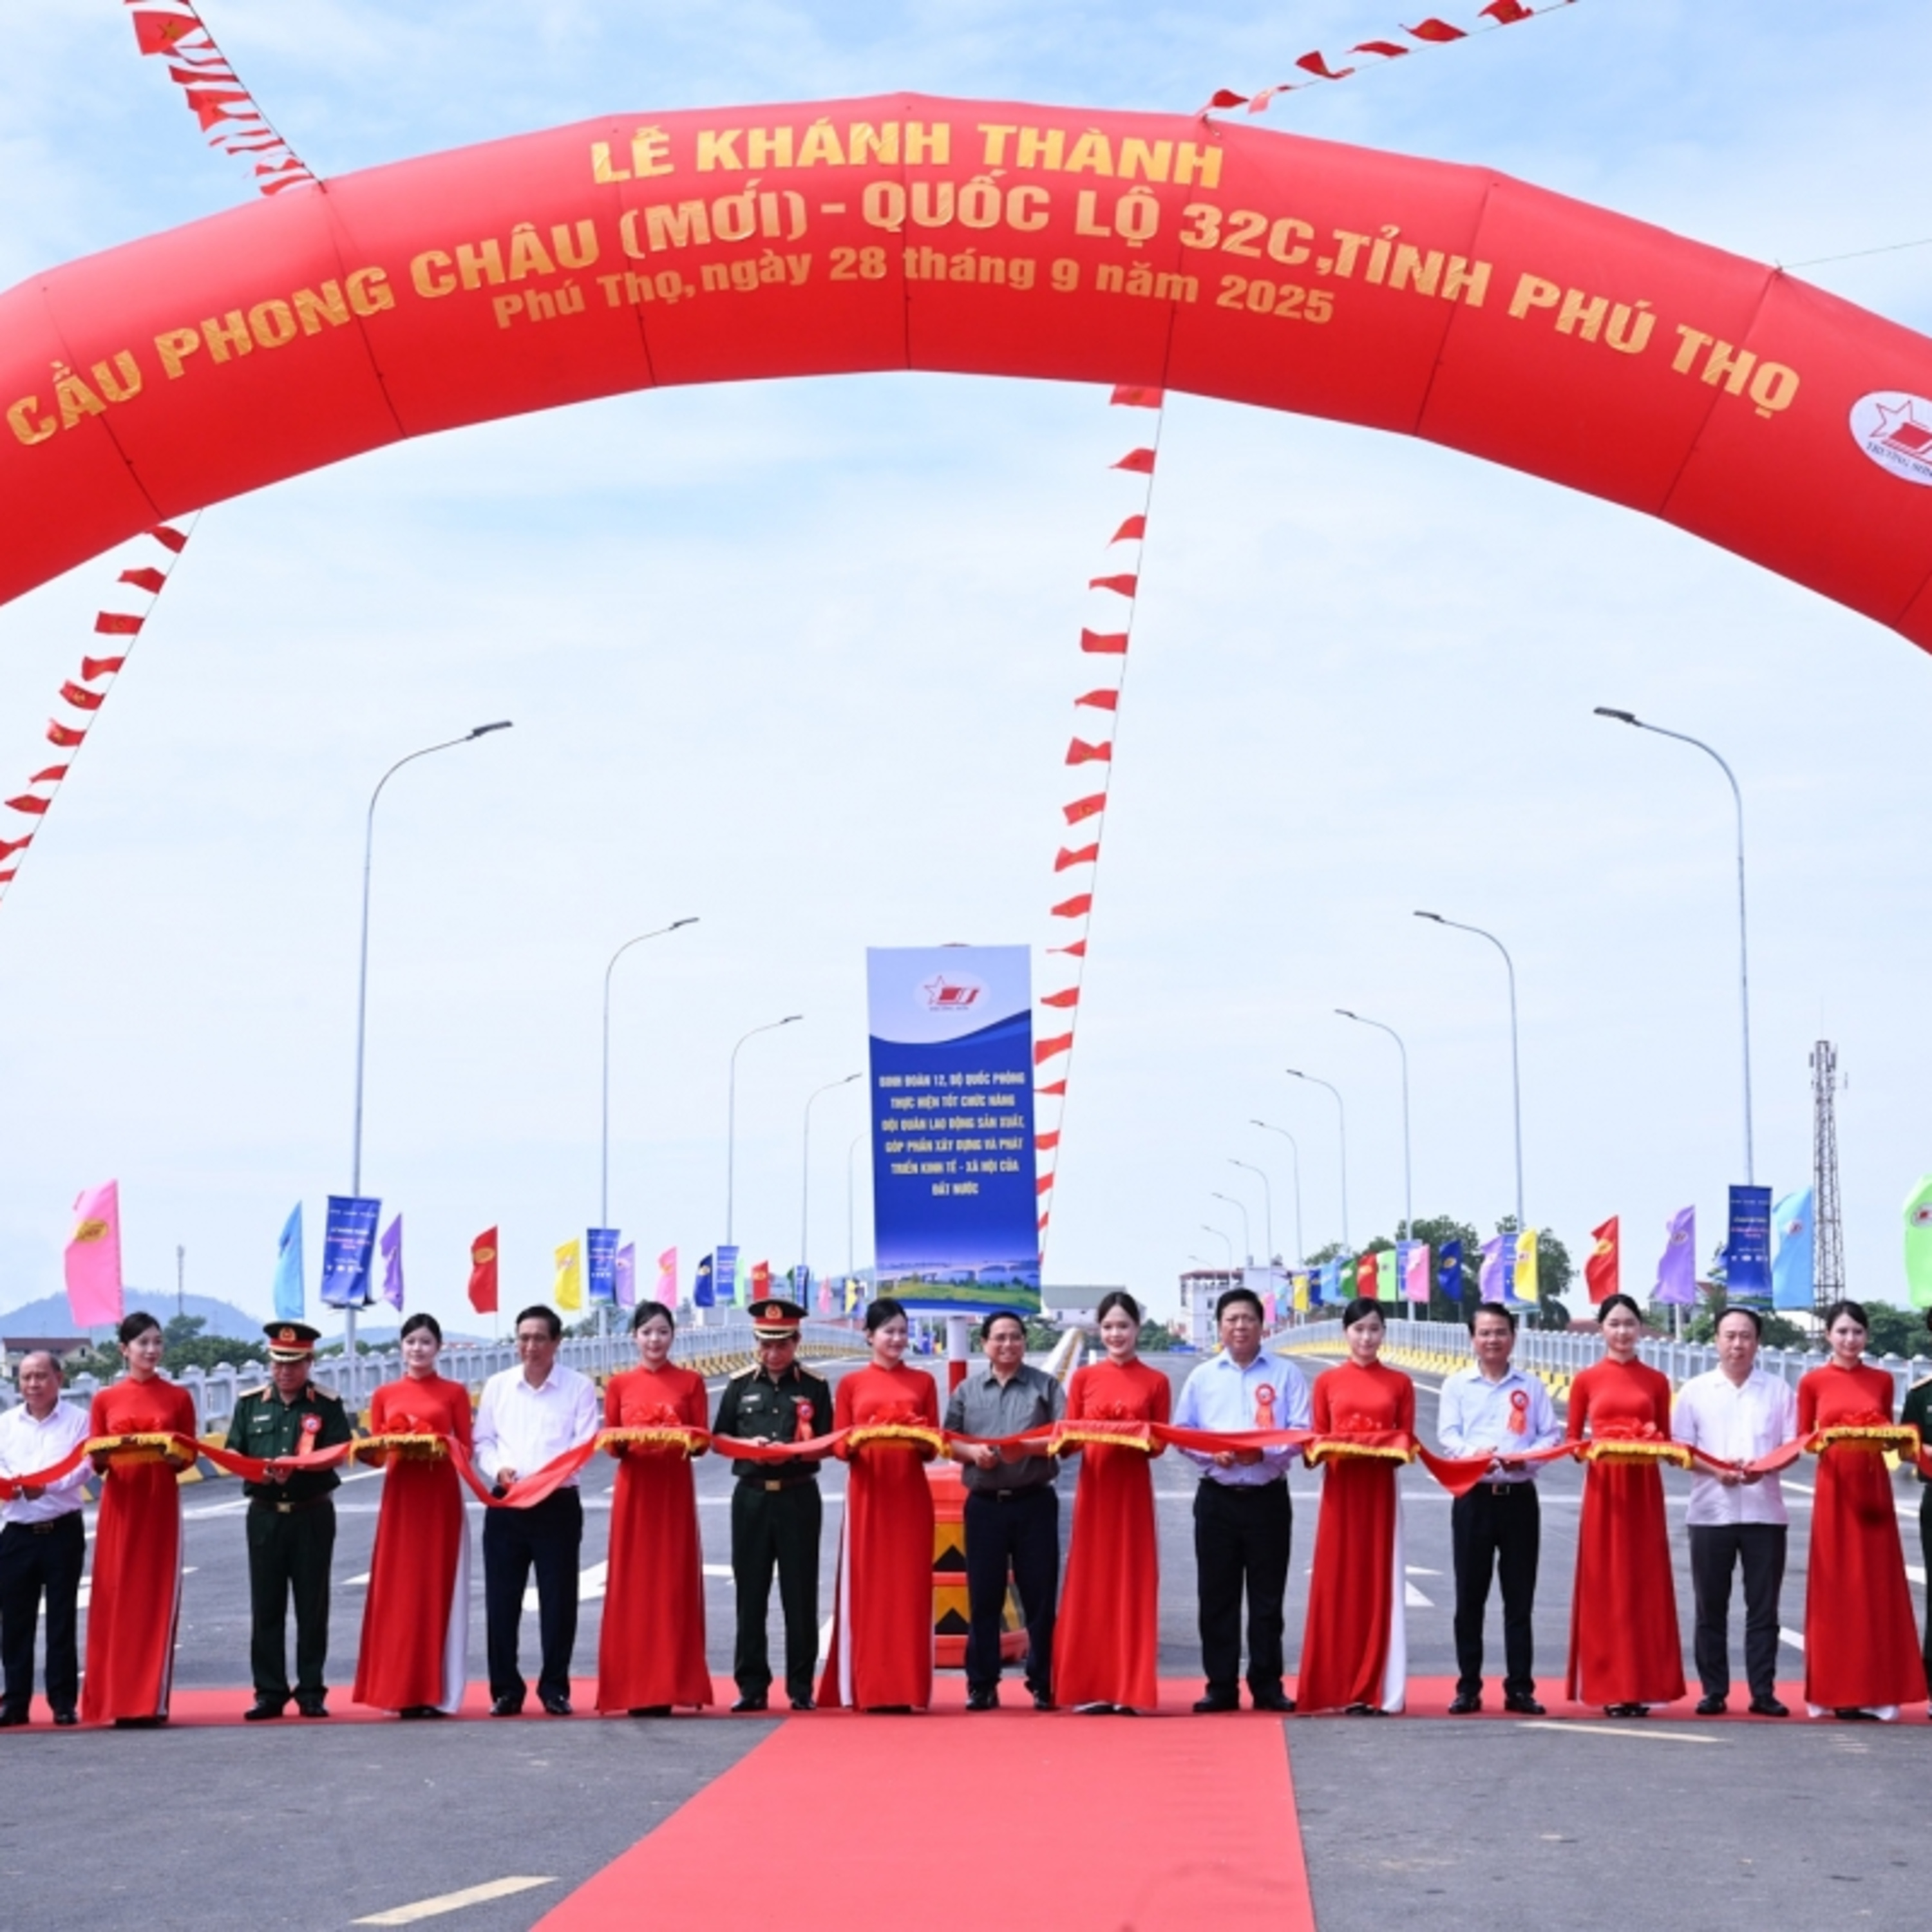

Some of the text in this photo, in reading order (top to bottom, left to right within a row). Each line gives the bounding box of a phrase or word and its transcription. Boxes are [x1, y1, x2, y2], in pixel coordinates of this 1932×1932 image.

[591, 116, 1224, 189] LỄ KHÁNH THÀNH
[5, 349, 143, 446] CẦU
[153, 266, 395, 381] PHONG
[409, 219, 600, 299] CHÂU
[620, 178, 808, 260] (MỚI)
[862, 169, 1050, 232] QUỐC
[1075, 185, 1160, 248] LỘ
[1508, 271, 1656, 355] PHÚ
[1671, 325, 1801, 419] THỌ
[493, 279, 585, 329] Phú
[700, 248, 811, 292] ngày
[829, 246, 887, 281] 28
[902, 246, 1036, 291] tháng
[1050, 258, 1079, 292] 9
[1095, 260, 1199, 303] năm
[1216, 274, 1335, 325] 2025
[966, 1070, 990, 1086] QUỐC
